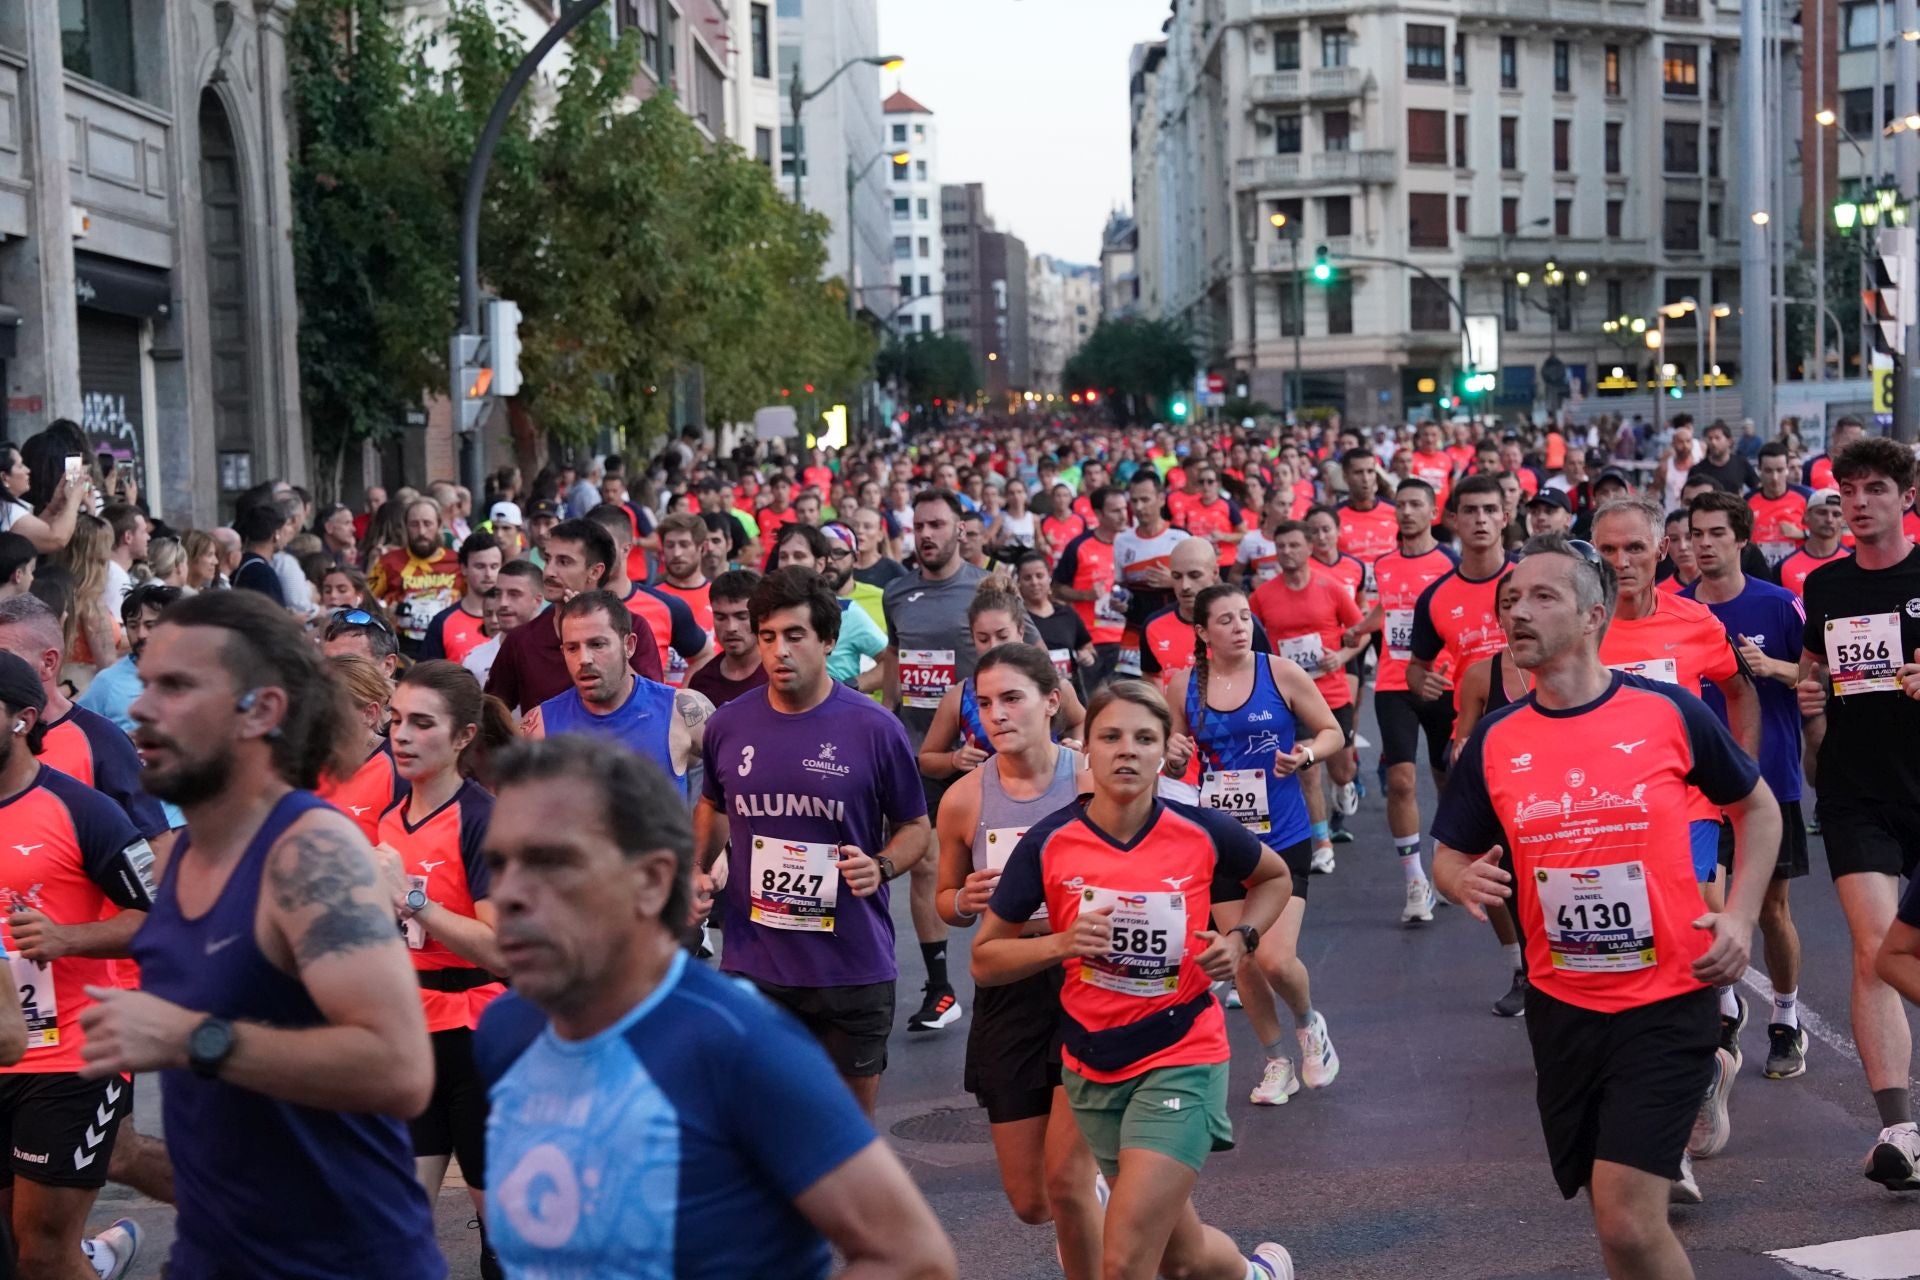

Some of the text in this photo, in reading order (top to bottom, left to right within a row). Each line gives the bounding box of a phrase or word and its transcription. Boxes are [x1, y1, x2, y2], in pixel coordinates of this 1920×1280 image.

[1837, 641, 1889, 663] 5366
[902, 669, 951, 685] 21944
[738, 745, 754, 777] 3
[802, 758, 850, 774] COMILLAS
[735, 793, 844, 822] ALUMNI
[1210, 793, 1255, 809] 5499
[762, 869, 824, 897] 8247
[1574, 893, 1604, 901] DANIEL
[1112, 917, 1149, 926] VIKTORIA
[1557, 902, 1632, 930] 4130
[1112, 927, 1167, 955] 585
[20, 984, 37, 1009] 2
[13, 1146, 50, 1164] hummel
